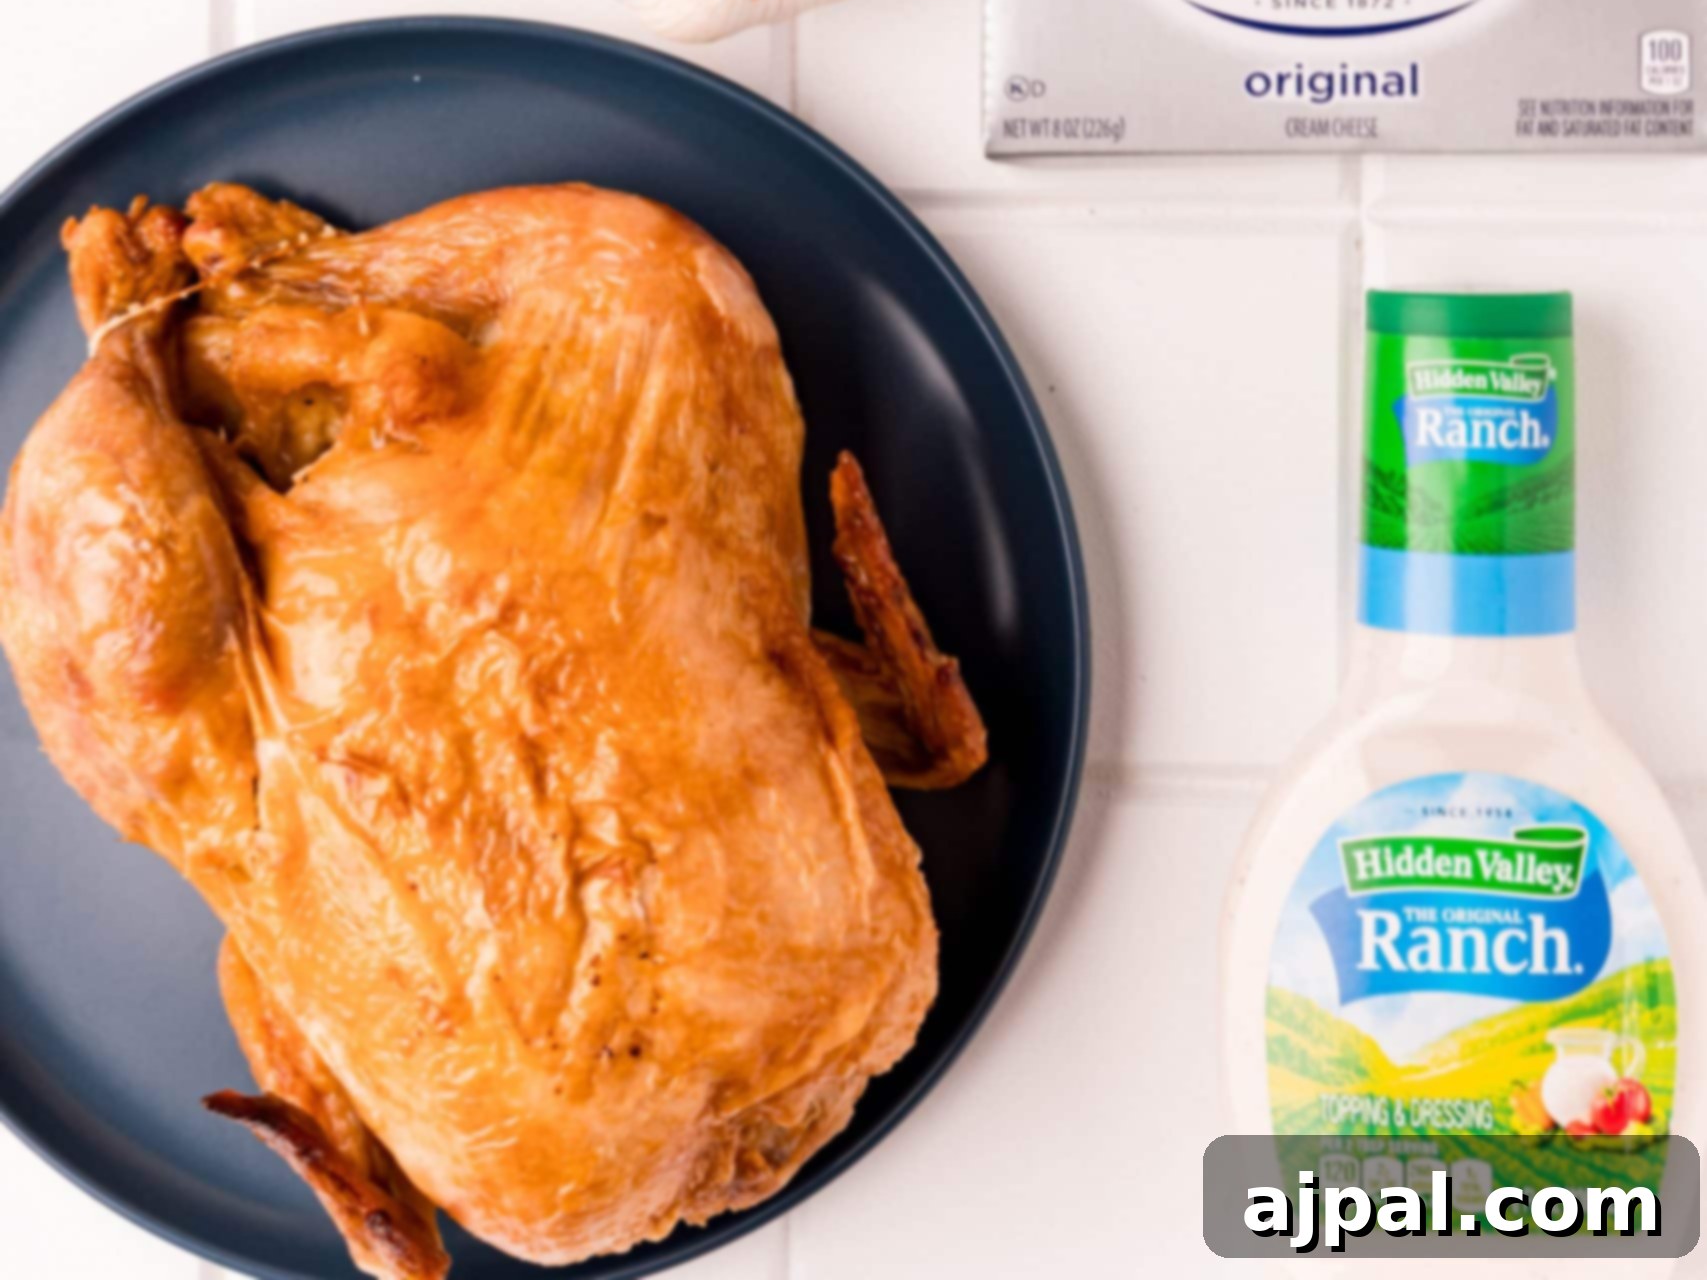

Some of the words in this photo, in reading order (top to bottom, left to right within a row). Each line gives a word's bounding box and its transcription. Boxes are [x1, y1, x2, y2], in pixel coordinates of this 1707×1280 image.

[1647, 37, 1684, 63] 100
[1244, 61, 1419, 104] original
[1284, 117, 1331, 139] CREAM
[1332, 117, 1379, 139] CHEESE
[1415, 368, 1488, 392] Hidden
[1489, 370, 1542, 399] Valley
[1352, 845, 1473, 882] Hidden
[1404, 906, 1438, 923] THE
[1441, 907, 1523, 926] ORIGINAL
[1319, 1094, 1388, 1128] TOPPING
[1393, 1098, 1406, 1128] &
[1409, 1097, 1495, 1131] DRESSING
